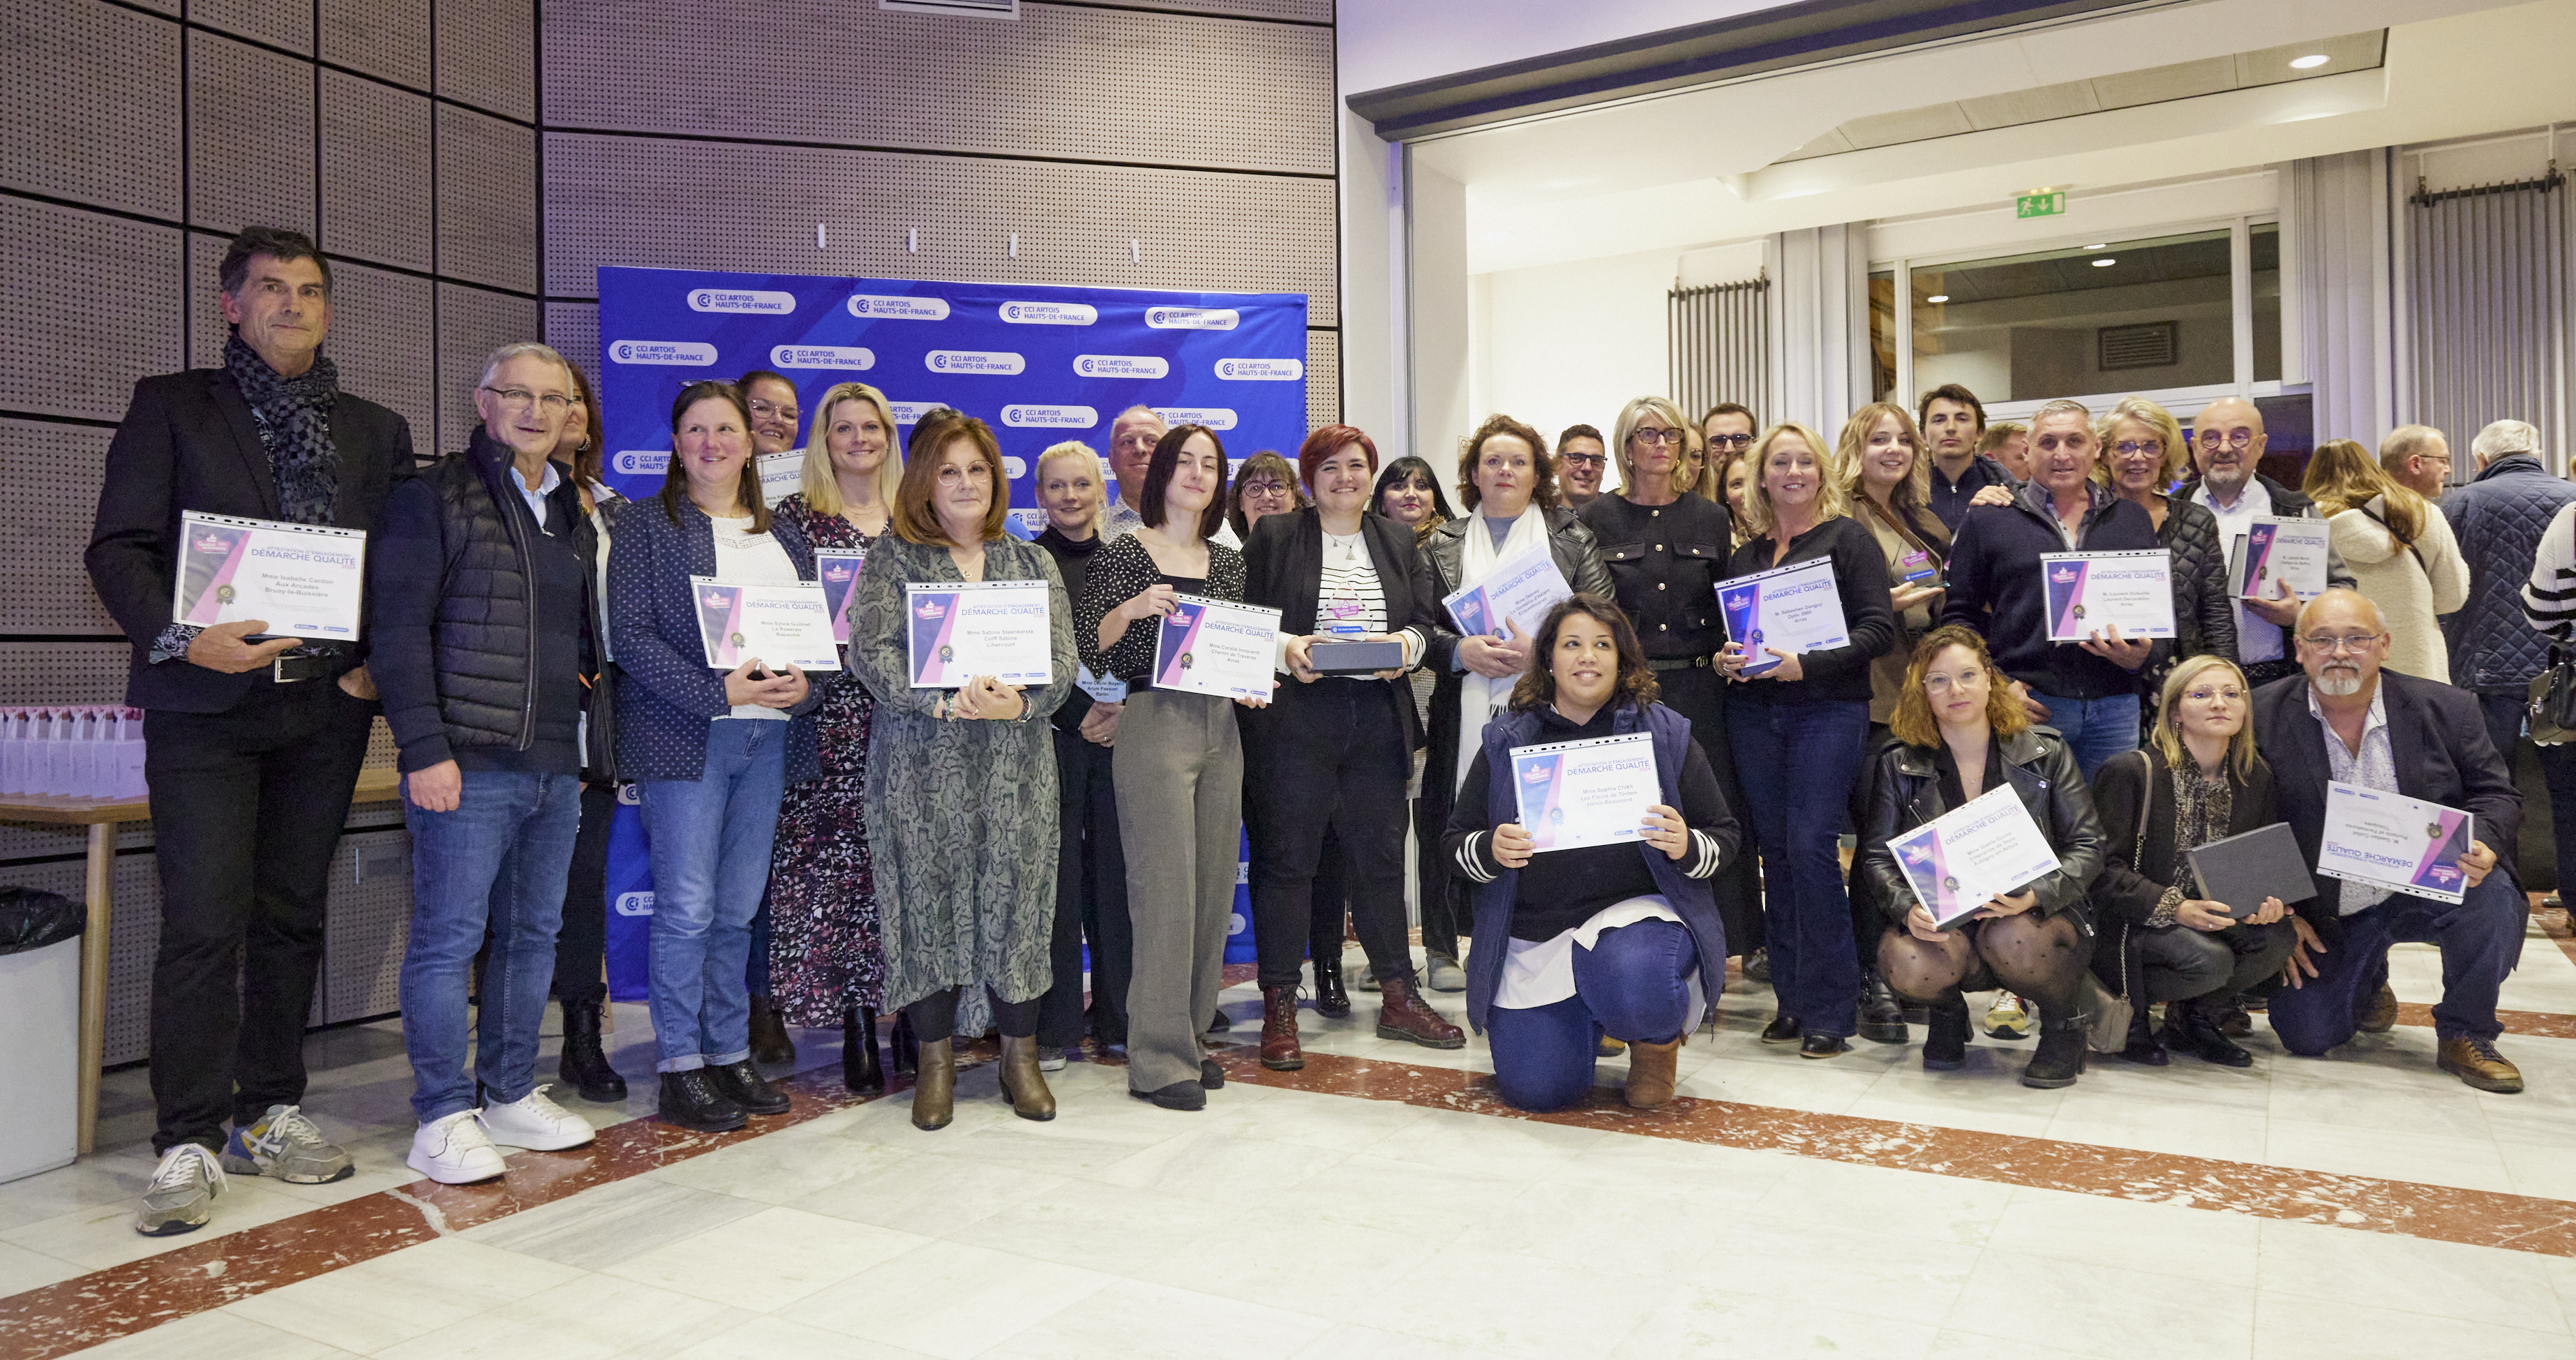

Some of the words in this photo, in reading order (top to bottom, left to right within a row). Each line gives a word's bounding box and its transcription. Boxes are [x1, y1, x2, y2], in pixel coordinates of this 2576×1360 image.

[715, 301, 782, 310] HAUTS-DE-FRANCE
[874, 307, 936, 315] HAUTS-DE-FRANCE
[1024, 313, 1085, 321] HAUTS-DE-FRANCE
[636, 353, 703, 361] HAUTS-DE-FRANCE
[797, 357, 862, 366] HAUTS-DE-FRANCE
[252, 548, 310, 561] DÉMARCHE
[313, 554, 355, 565] QUALITÉ
[1491, 577, 1525, 600] DÉMARCHE
[1525, 560, 1550, 579] QUALITÉ
[2091, 571, 2132, 580] DÉMARCHE
[1764, 589, 1802, 601] DÉMARCHE
[1804, 580, 1832, 592] QUALITÉ
[747, 601, 790, 609] DÉMARCHE
[1011, 606, 1044, 614] QUALITÉ
[1516, 598, 1534, 611] Domaine
[1205, 622, 1243, 634] DÉMARCHE
[1246, 629, 1274, 638] QUALITÉ
[1241, 624, 1271, 632] D'ENGAGEMENT
[1568, 765, 1613, 776] DÉMARCHE
[1616, 759, 1649, 770] QUALITÉ
[1945, 821, 1987, 845] DÉMARCHE
[1989, 803, 2020, 823] QUALITÉ
[1954, 821, 1980, 835] ATTESTATION
[1970, 849, 1994, 861] Empreinte
[2002, 837, 2016, 846] Style
[1974, 843, 2019, 866] Aubigny-en-Artois
[2327, 844, 2361, 856] QUALITÉ
[2365, 852, 2413, 868] DÉMARCHE
